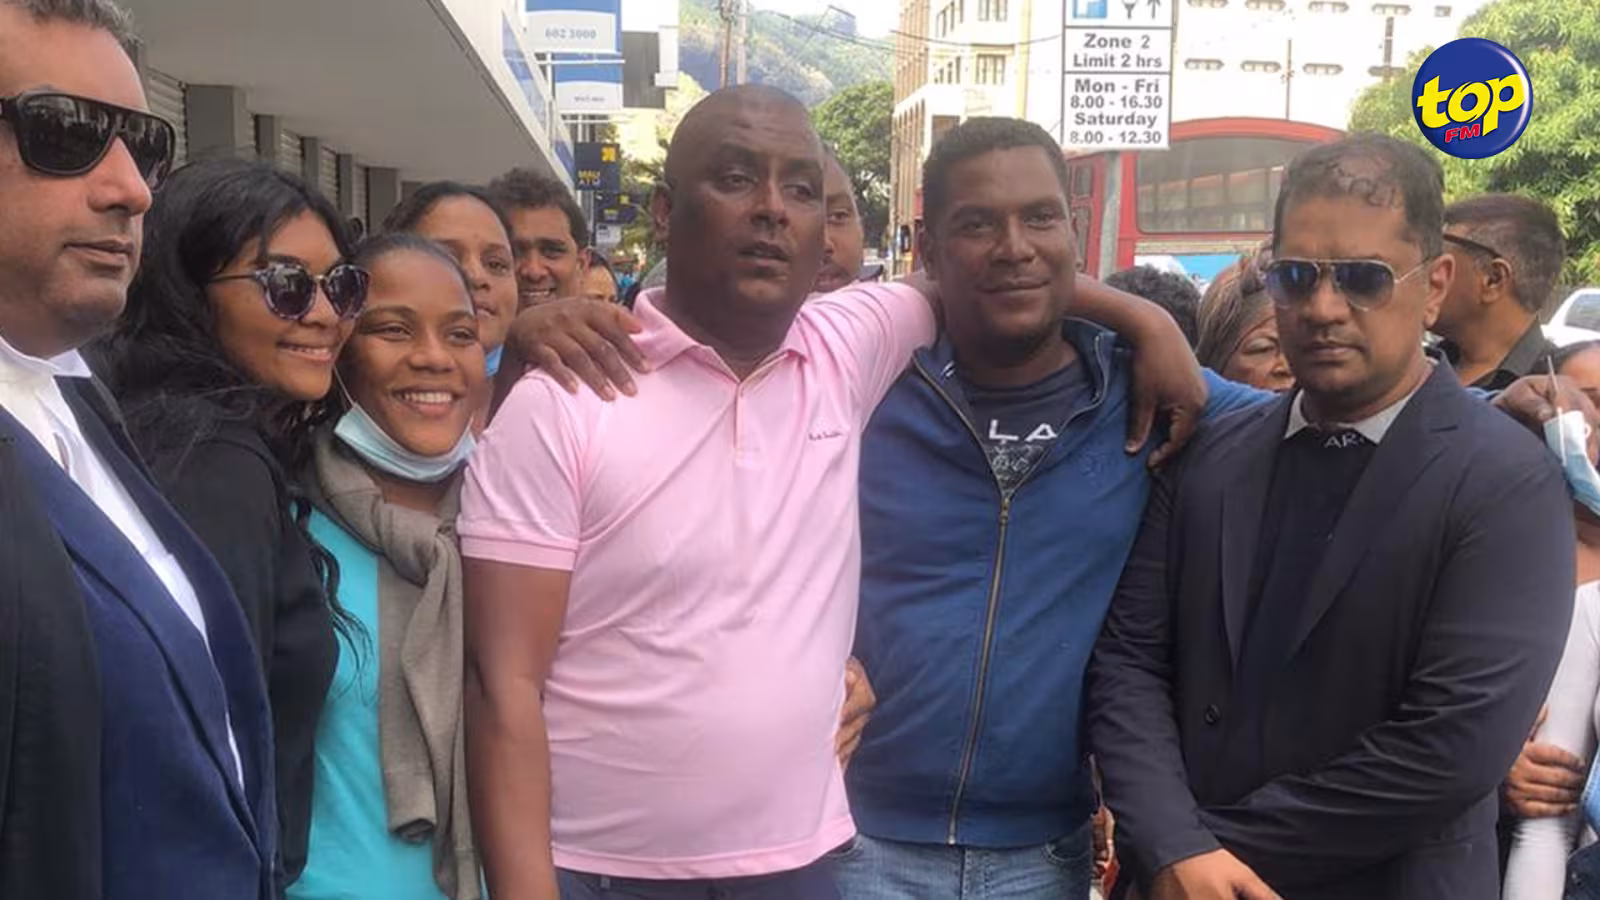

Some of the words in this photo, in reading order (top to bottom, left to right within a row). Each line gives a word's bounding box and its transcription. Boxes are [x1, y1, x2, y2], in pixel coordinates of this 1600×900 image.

[1083, 33, 1132, 48] Zone
[1141, 35, 1150, 49] 2
[1073, 53, 1115, 67] Limit
[1121, 54, 1131, 67] 2
[1136, 54, 1162, 68] hrs
[1074, 78, 1115, 93] Mon
[1135, 79, 1160, 93] Fri
[1070, 95, 1105, 109] 8.00
[1120, 95, 1162, 109] 16.30
[1074, 111, 1157, 128] Saturday
[1070, 131, 1104, 144] 8.00
[1120, 131, 1162, 144] 12.30
[1324, 433, 1365, 449] AR
